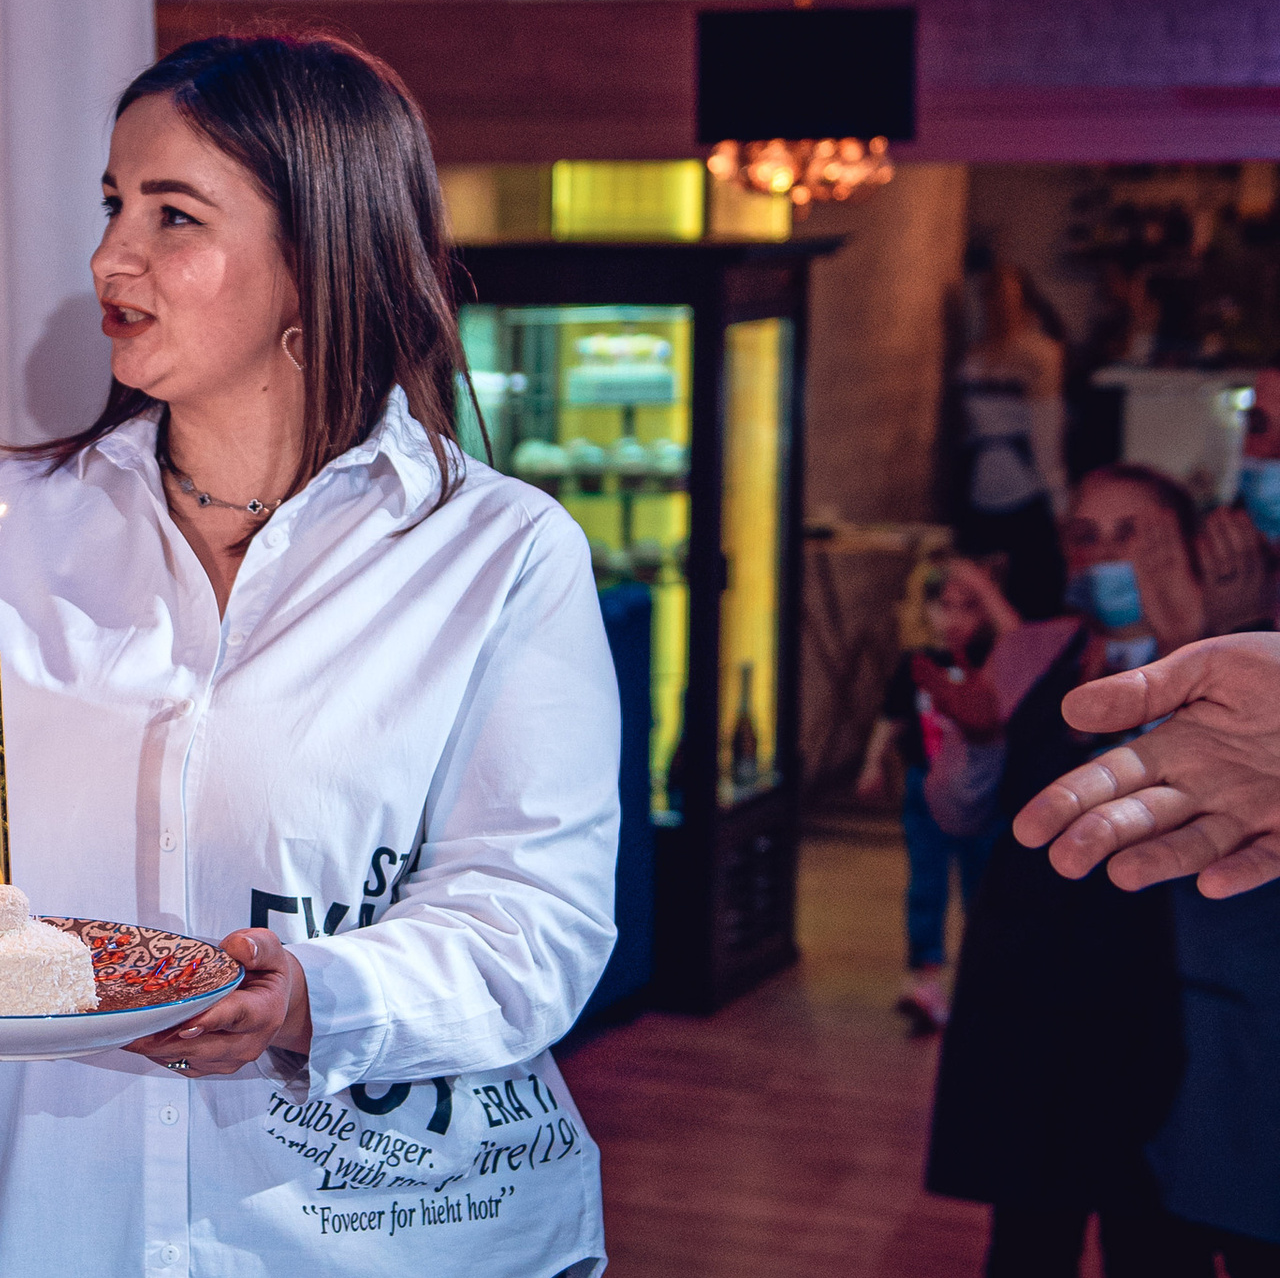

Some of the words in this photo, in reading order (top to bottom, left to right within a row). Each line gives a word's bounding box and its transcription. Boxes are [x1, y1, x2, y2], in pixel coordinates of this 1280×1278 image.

[359, 1128, 434, 1169] anger.
[335, 1157, 387, 1189] with
[389, 1201, 416, 1236] for
